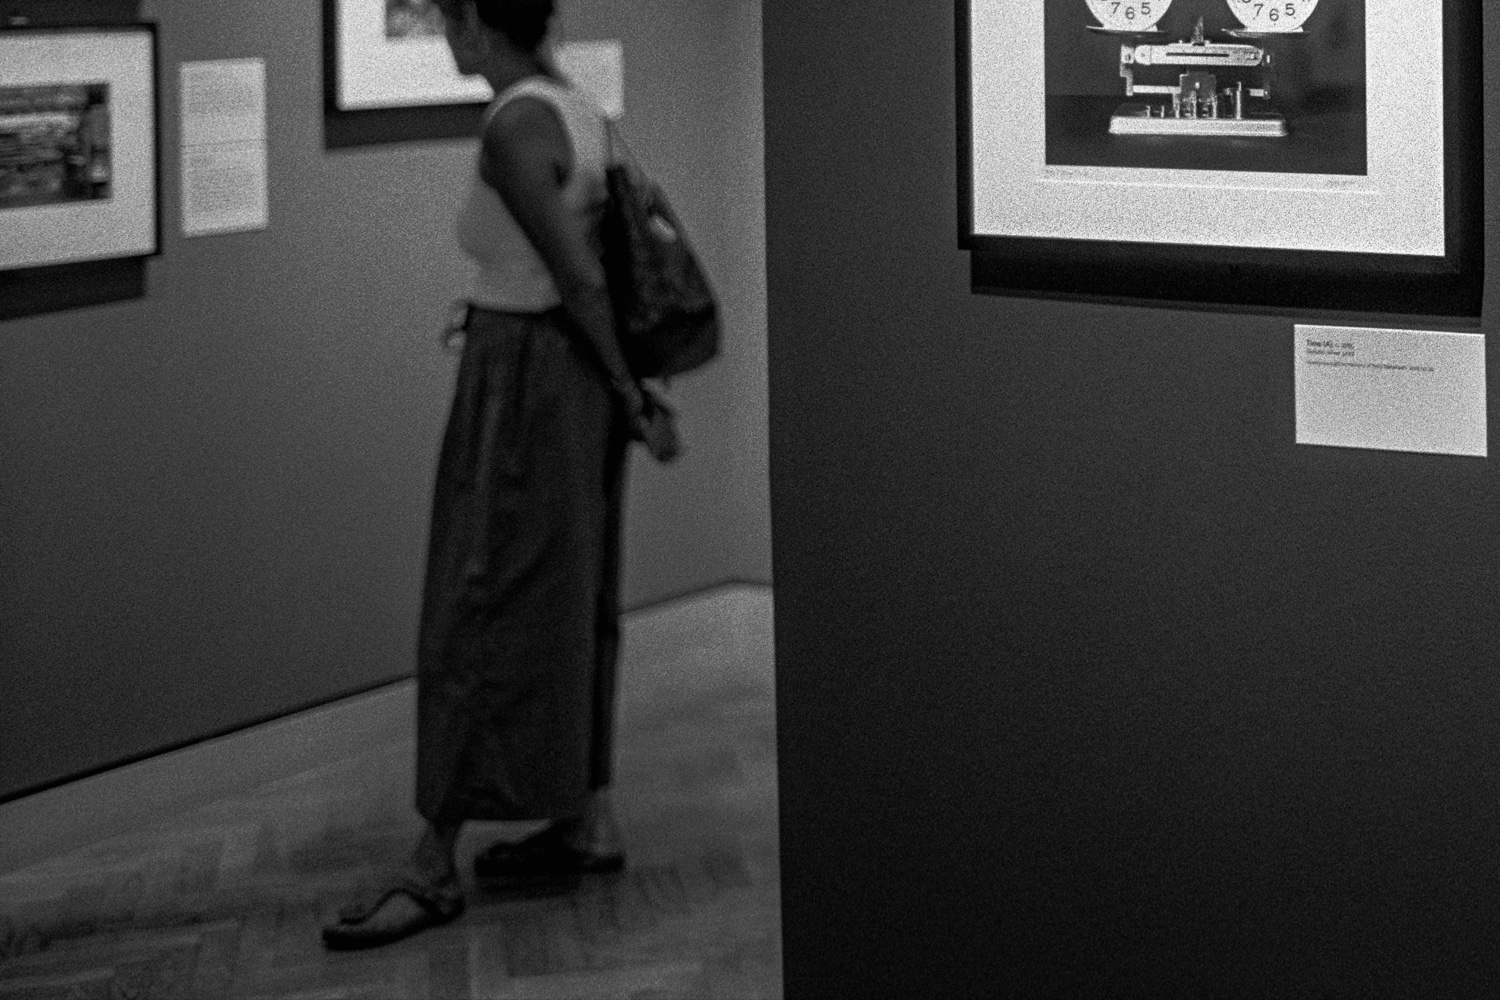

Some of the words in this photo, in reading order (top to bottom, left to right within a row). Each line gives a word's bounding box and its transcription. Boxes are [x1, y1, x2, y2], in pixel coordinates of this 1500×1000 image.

[1111, 2, 1120, 14] 7
[1126, 6, 1135, 20] 6
[1142, 2, 1150, 15] 5
[1254, 4, 1264, 16] 7
[1270, 8, 1279, 21] 6
[1285, 3, 1295, 16] 5
